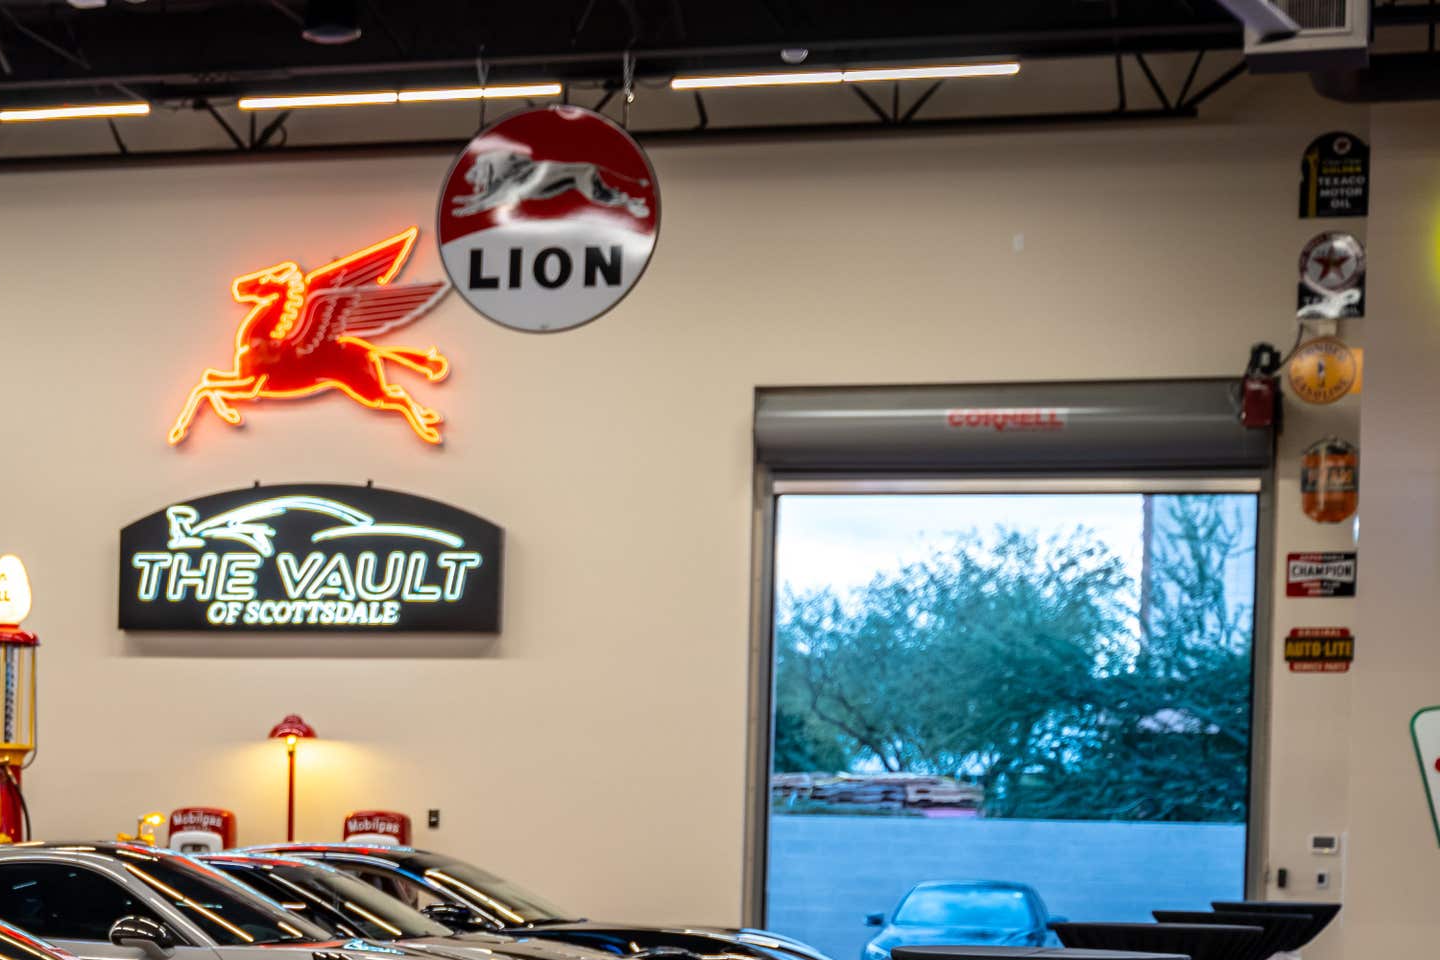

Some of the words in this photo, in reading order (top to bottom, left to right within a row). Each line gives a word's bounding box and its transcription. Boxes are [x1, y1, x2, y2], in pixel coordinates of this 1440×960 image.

[1318, 176, 1365, 186] TEXACO
[1319, 187, 1363, 198] MOTOR
[1330, 199, 1351, 209] OIL
[469, 245, 623, 291] LION
[133, 551, 264, 601] THE
[276, 550, 482, 602] VAULT
[1291, 563, 1353, 577] CHAMPION
[207, 600, 244, 624] OF
[244, 600, 401, 625] SCOTTSDALE
[172, 811, 223, 829] Mobilgas
[346, 817, 400, 834] Mobilgas
